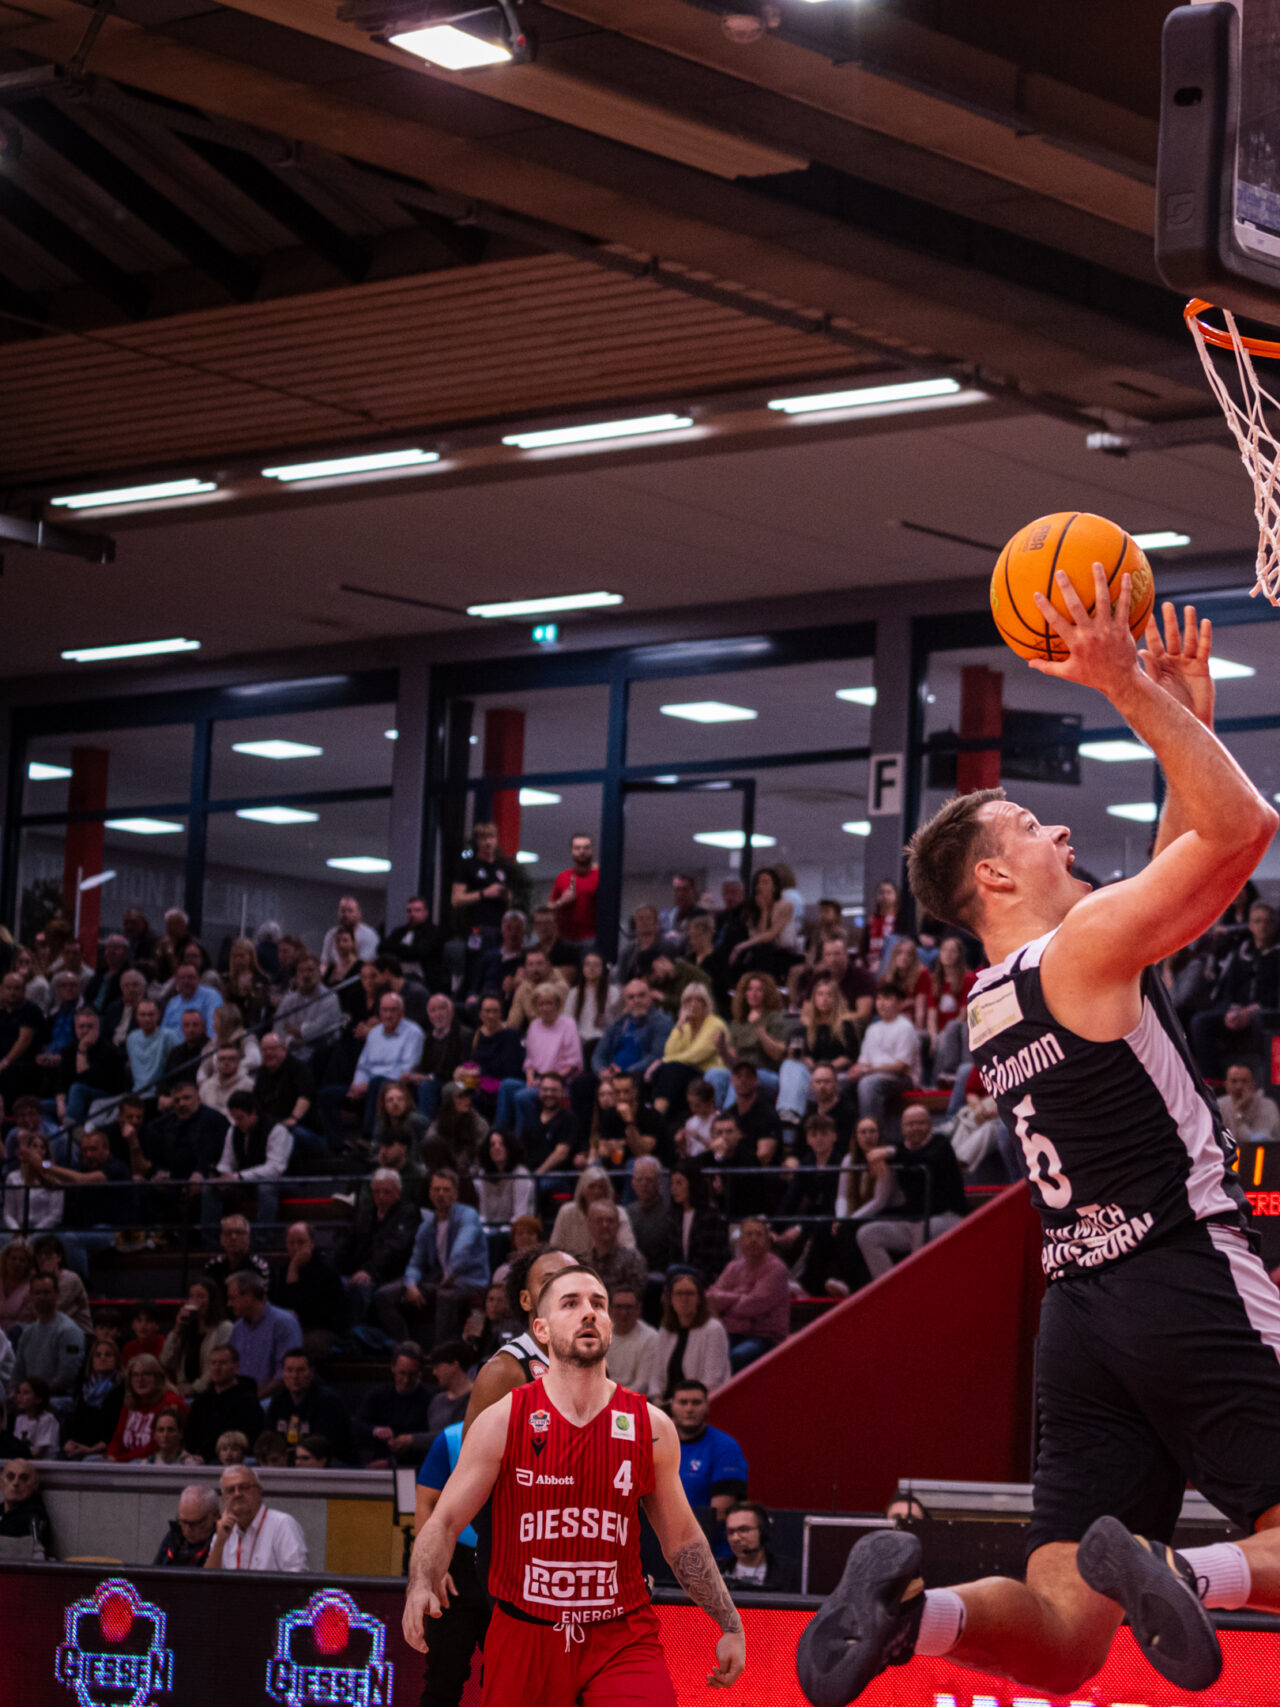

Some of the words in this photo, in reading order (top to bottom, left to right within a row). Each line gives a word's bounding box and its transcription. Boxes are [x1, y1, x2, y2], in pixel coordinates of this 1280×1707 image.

[873, 759, 898, 811] F
[535, 1474, 575, 1486] Abbott
[613, 1459, 634, 1497] 4
[519, 1506, 630, 1547] GIESSEN
[530, 1564, 617, 1599] ROTH
[561, 1606, 625, 1624] ENERGIE
